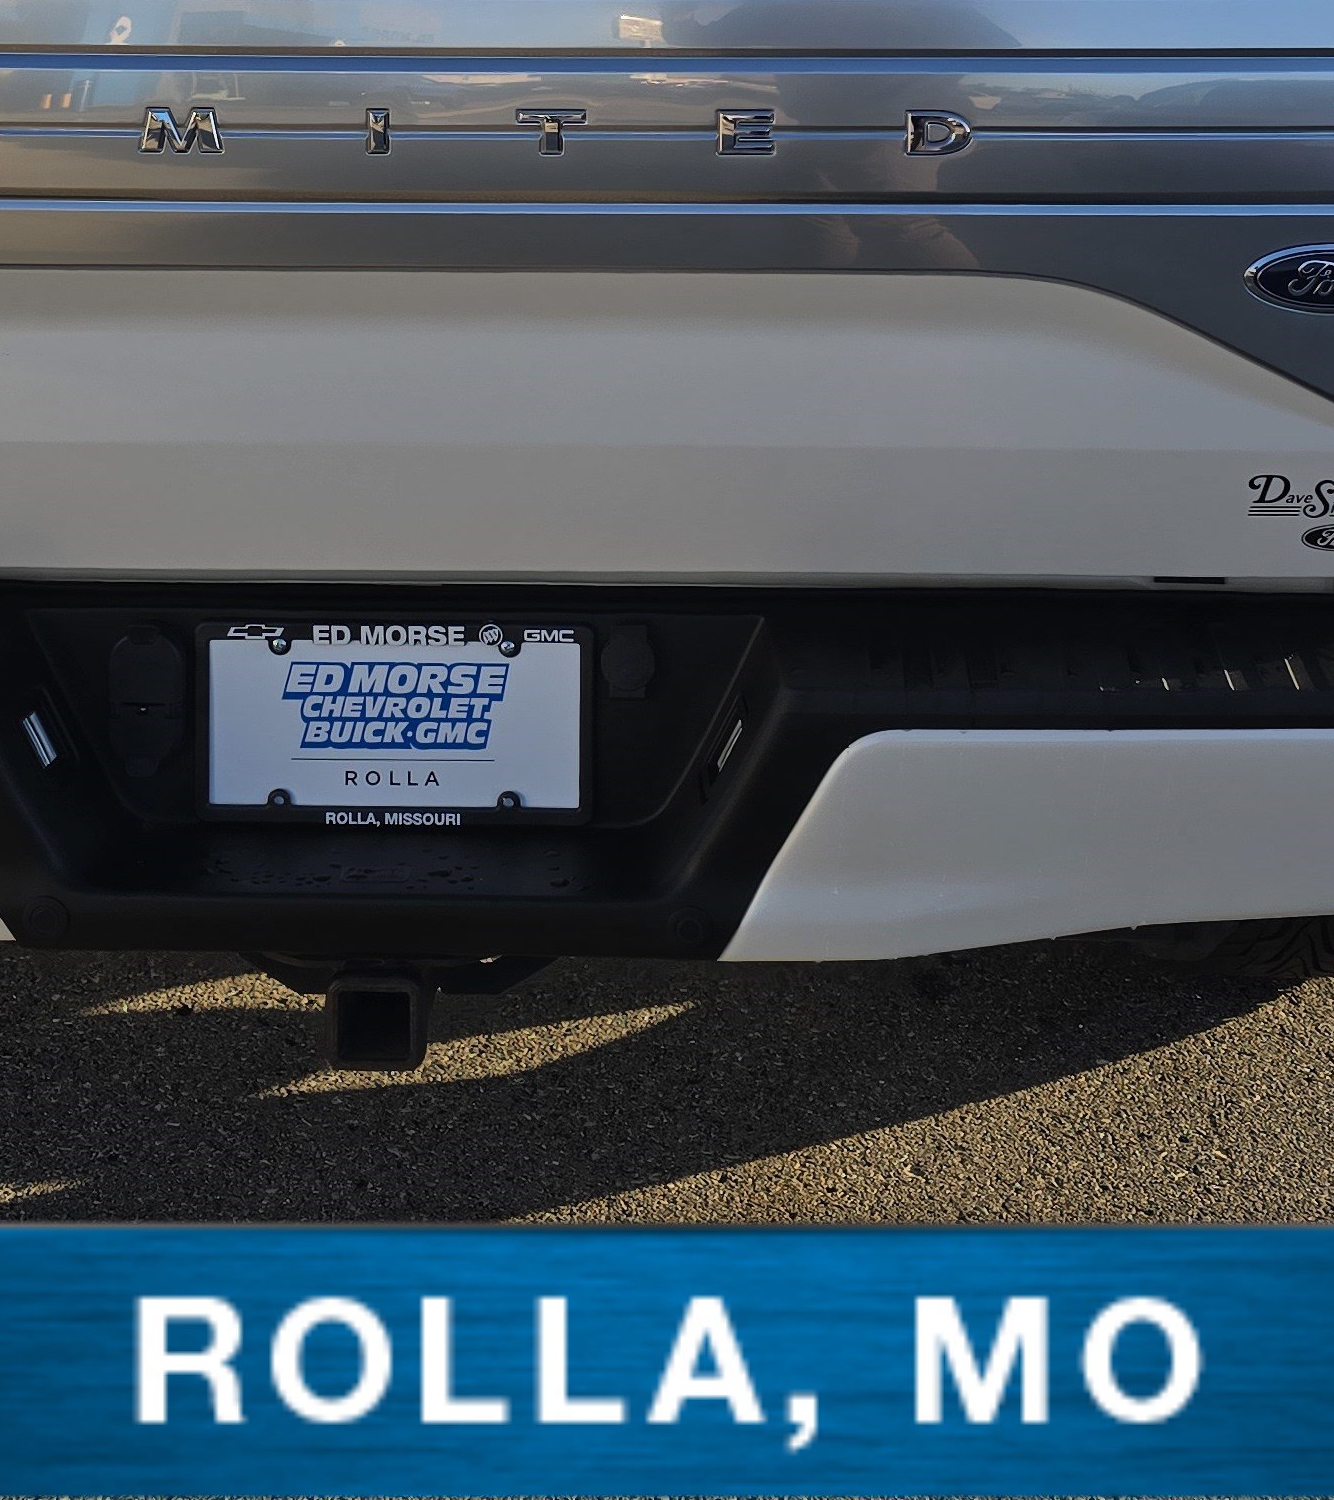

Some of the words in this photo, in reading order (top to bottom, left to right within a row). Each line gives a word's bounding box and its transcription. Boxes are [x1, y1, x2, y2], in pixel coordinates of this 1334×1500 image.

[1248, 474, 1314, 504] Dave
[312, 624, 351, 645] ED
[360, 625, 466, 646] MORSE
[523, 629, 575, 643] GMC
[285, 663, 346, 693] ED
[347, 663, 508, 695] MORSE
[302, 694, 490, 719] CHEVROLET
[344, 770, 440, 787] ROLLA
[325, 812, 381, 828] ROLLA,
[384, 812, 462, 827] MISSOURI
